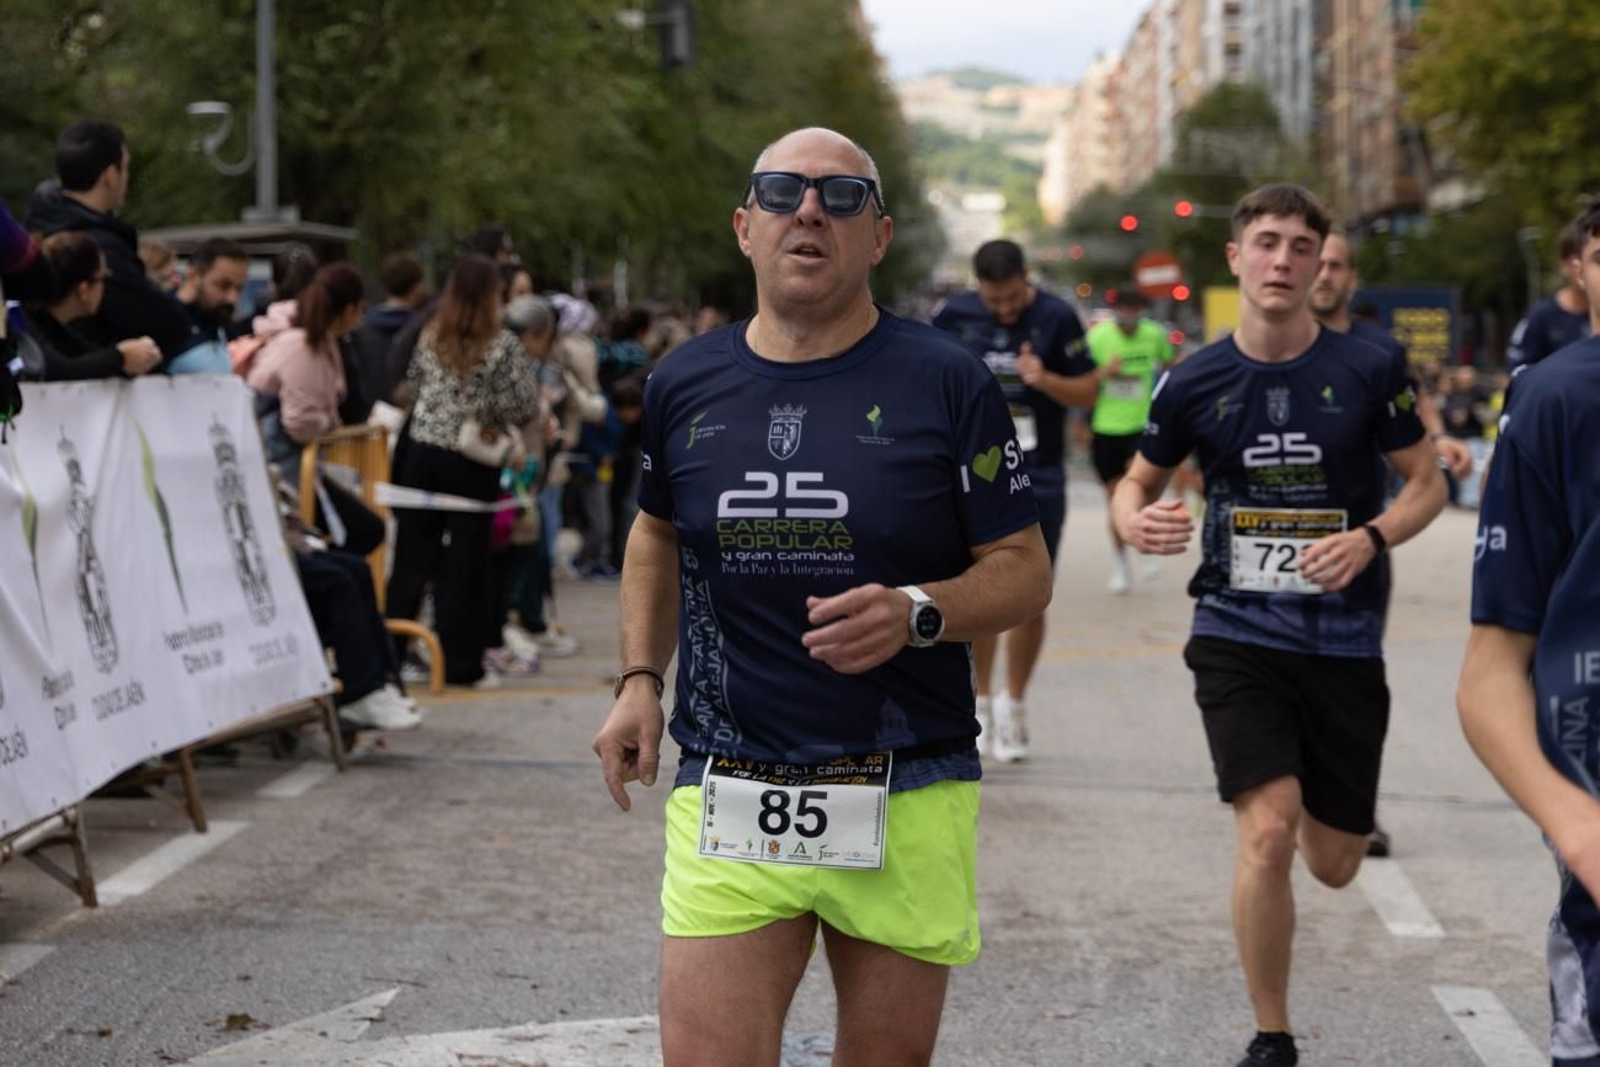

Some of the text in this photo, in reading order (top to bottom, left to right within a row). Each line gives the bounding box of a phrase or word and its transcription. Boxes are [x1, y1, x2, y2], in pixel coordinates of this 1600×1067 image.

[1242, 432, 1322, 468] 25
[717, 471, 849, 519] 25
[716, 519, 849, 534] CARRERA
[718, 534, 854, 550] POPULAR
[721, 551, 855, 561] y gran caminata
[1254, 542, 1313, 573] 72
[817, 765, 883, 775] caminata
[758, 789, 828, 839] 85
